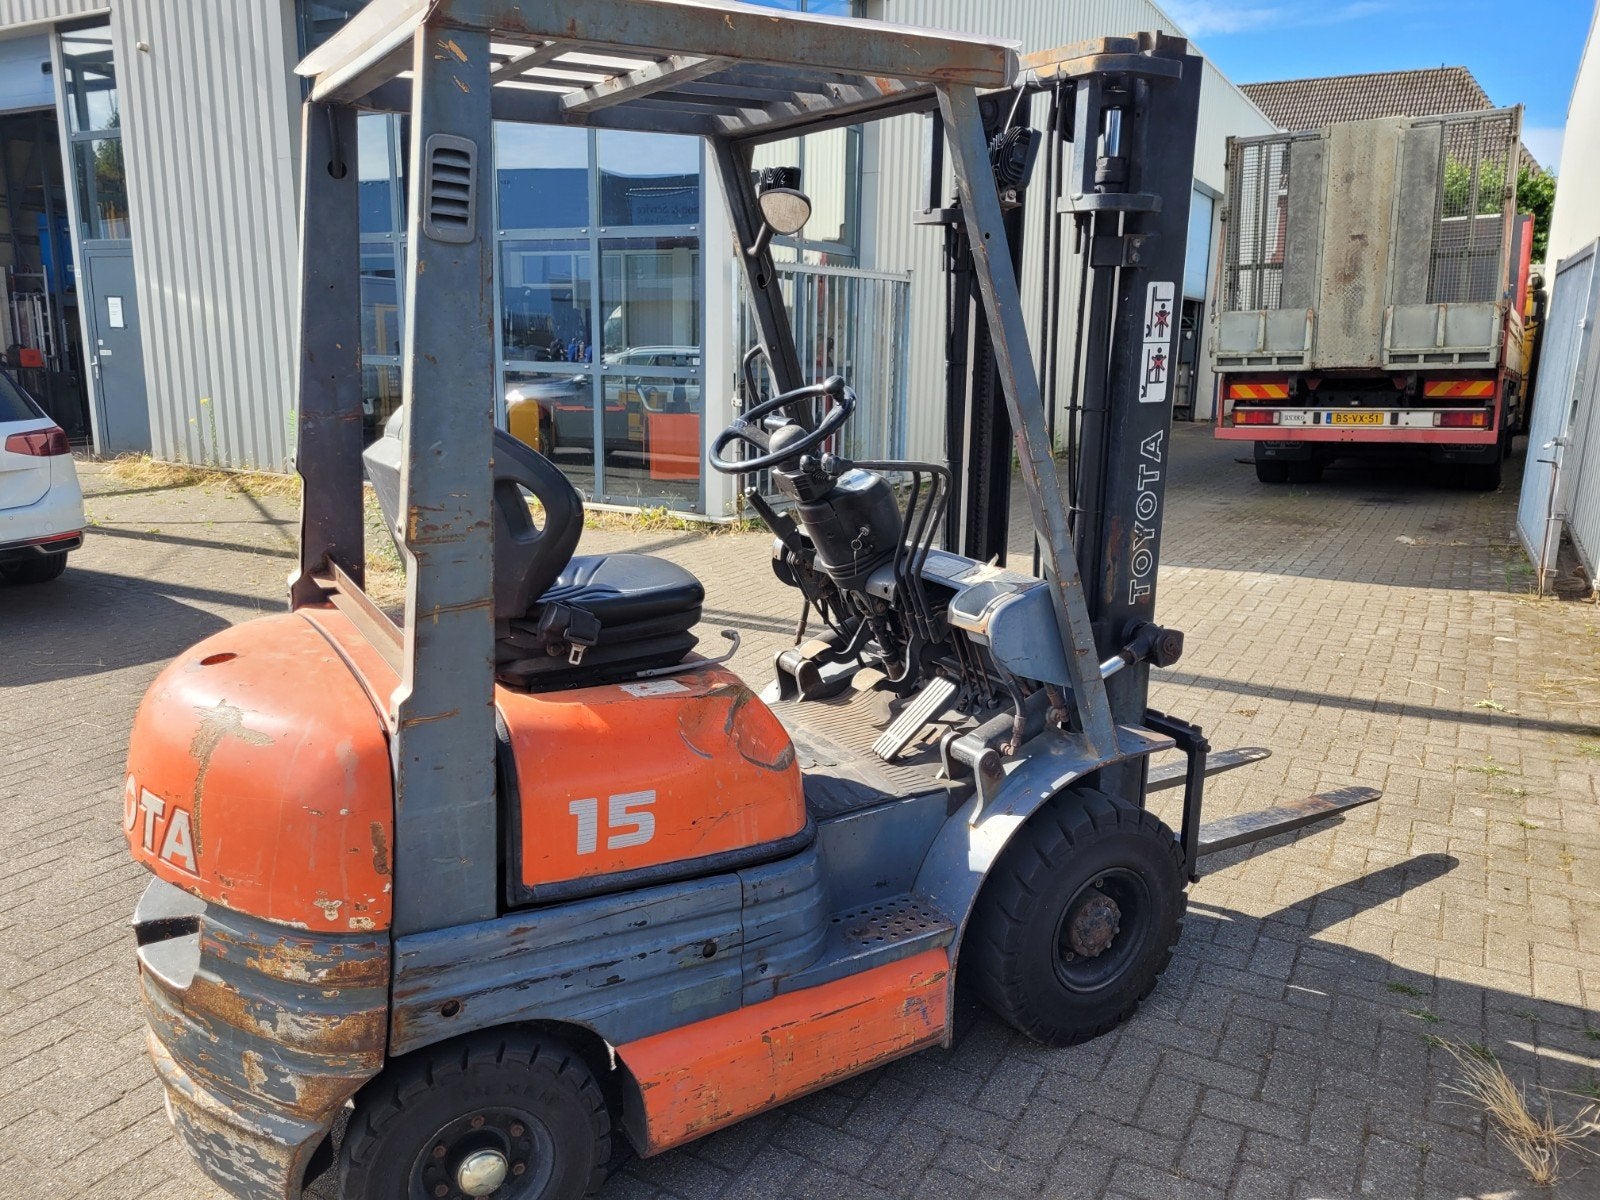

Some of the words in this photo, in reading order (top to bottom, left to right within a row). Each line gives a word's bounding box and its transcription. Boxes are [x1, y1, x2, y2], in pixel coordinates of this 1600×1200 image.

[1336, 413, 1379, 423] BS-VX-51
[1129, 430, 1163, 605] TOYOTA
[569, 789, 657, 855] 15
